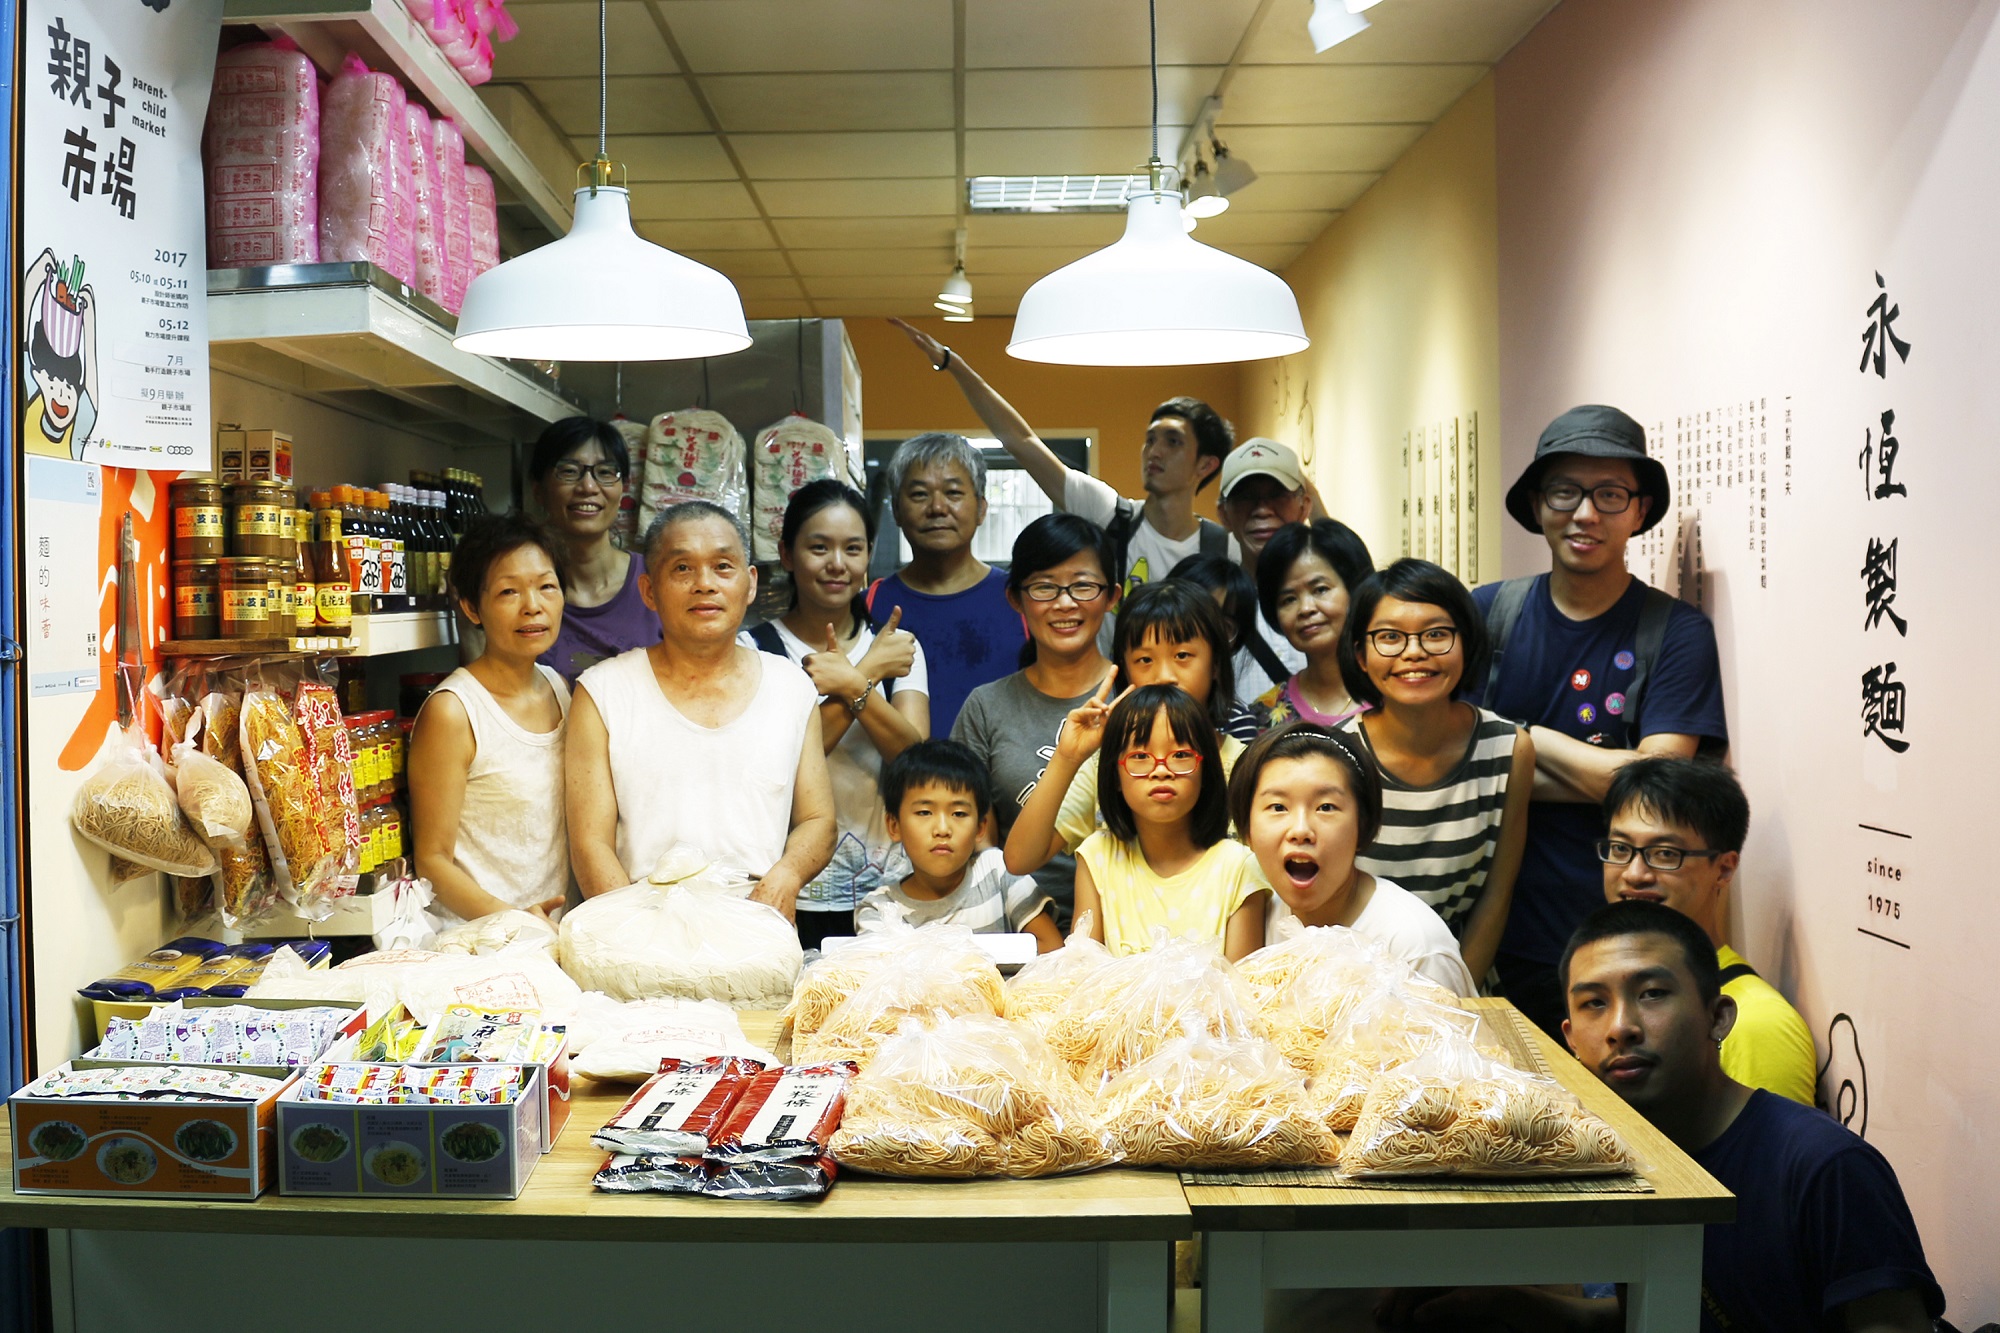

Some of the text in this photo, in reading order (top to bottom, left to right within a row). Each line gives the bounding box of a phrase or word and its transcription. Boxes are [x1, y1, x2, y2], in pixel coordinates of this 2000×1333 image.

[47, 17, 125, 128] 親子
[132, 76, 167, 99] parent-
[142, 100, 167, 119] child
[132, 115, 166, 138] market
[62, 126, 136, 220] 市場
[154, 249, 188, 268] 2017
[130, 270, 151, 283] 05.10
[160, 277, 187, 290] 05.11
[159, 318, 189, 331] 05.12
[167, 354, 184, 367] 7月
[1867, 857, 1902, 881] since
[1868, 894, 1901, 920] 1975
